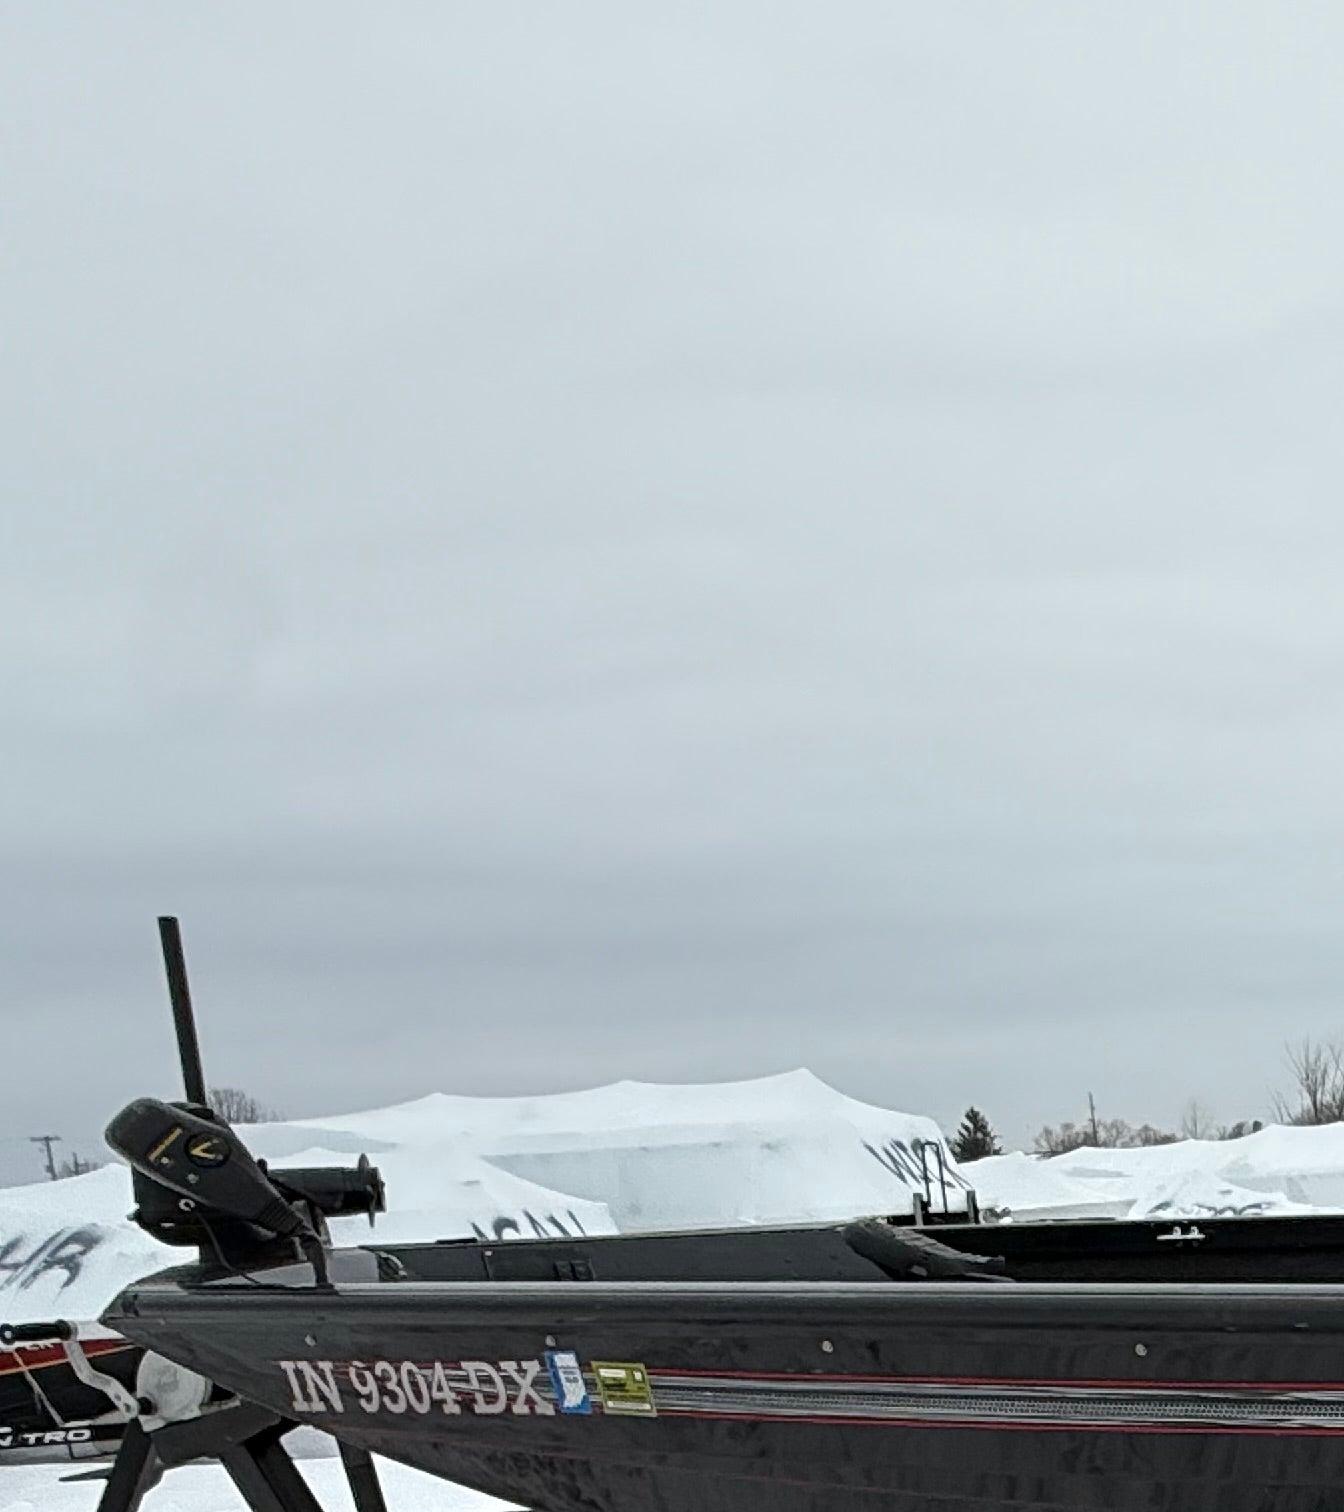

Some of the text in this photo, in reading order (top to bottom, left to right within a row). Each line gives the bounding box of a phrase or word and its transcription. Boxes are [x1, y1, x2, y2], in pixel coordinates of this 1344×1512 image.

[280, 1360, 345, 1414] IN
[349, 1360, 462, 1415] 9304
[459, 1360, 555, 1416] DX
